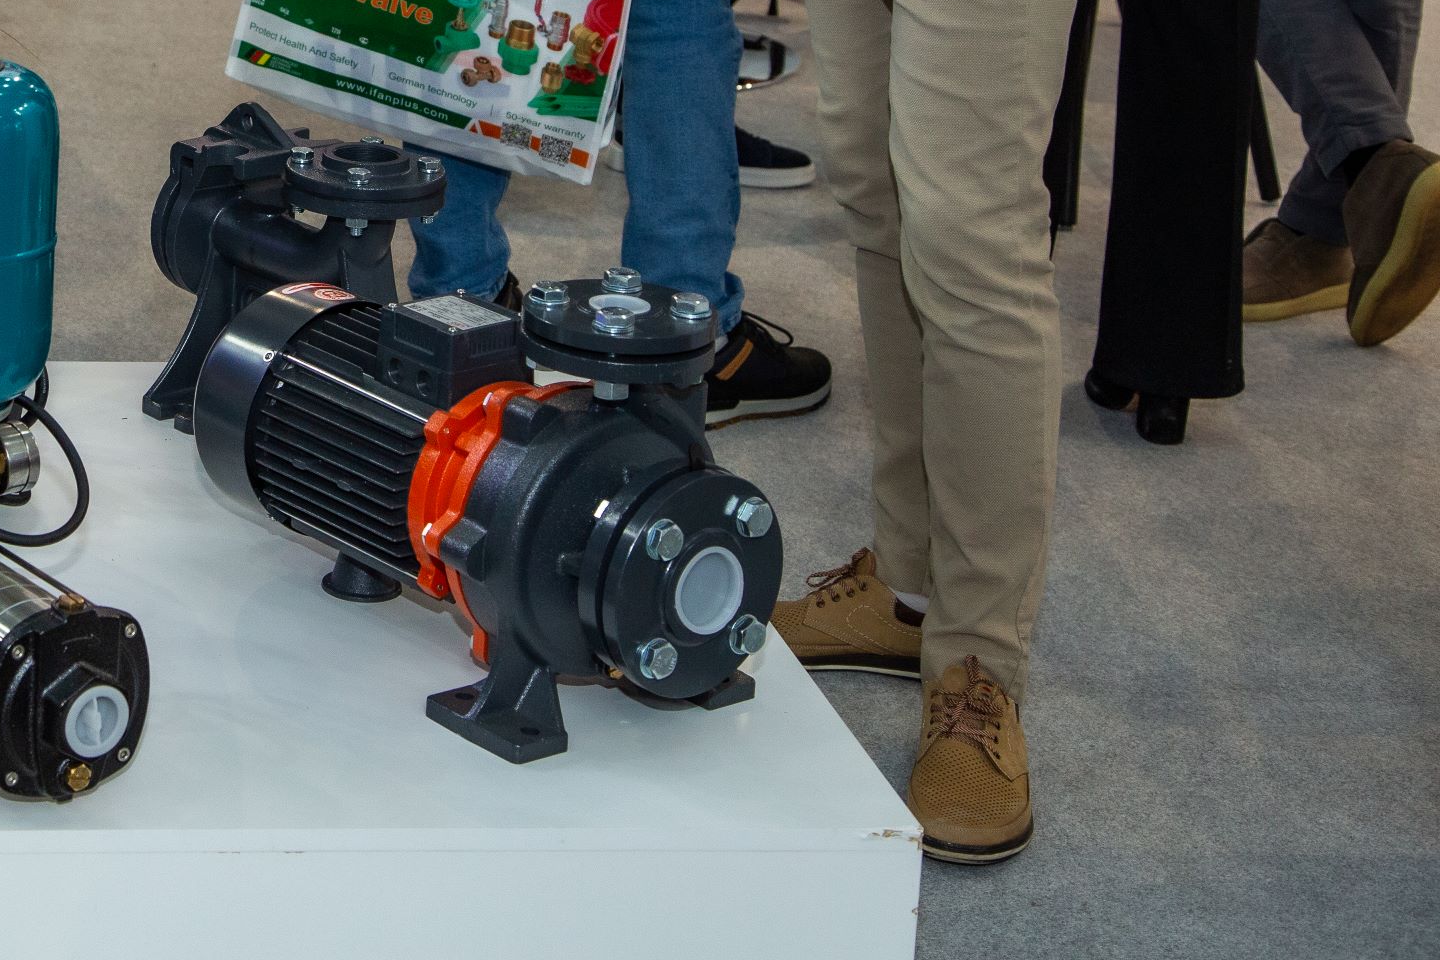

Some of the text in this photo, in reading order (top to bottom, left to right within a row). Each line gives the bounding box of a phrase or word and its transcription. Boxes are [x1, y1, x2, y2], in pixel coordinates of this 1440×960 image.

[249, 21, 359, 70] Protect Health And Safety
[336, 78, 449, 121] www.ifanplus.com
[388, 71, 478, 109] German technology
[506, 111, 587, 141] 50-year warranty
